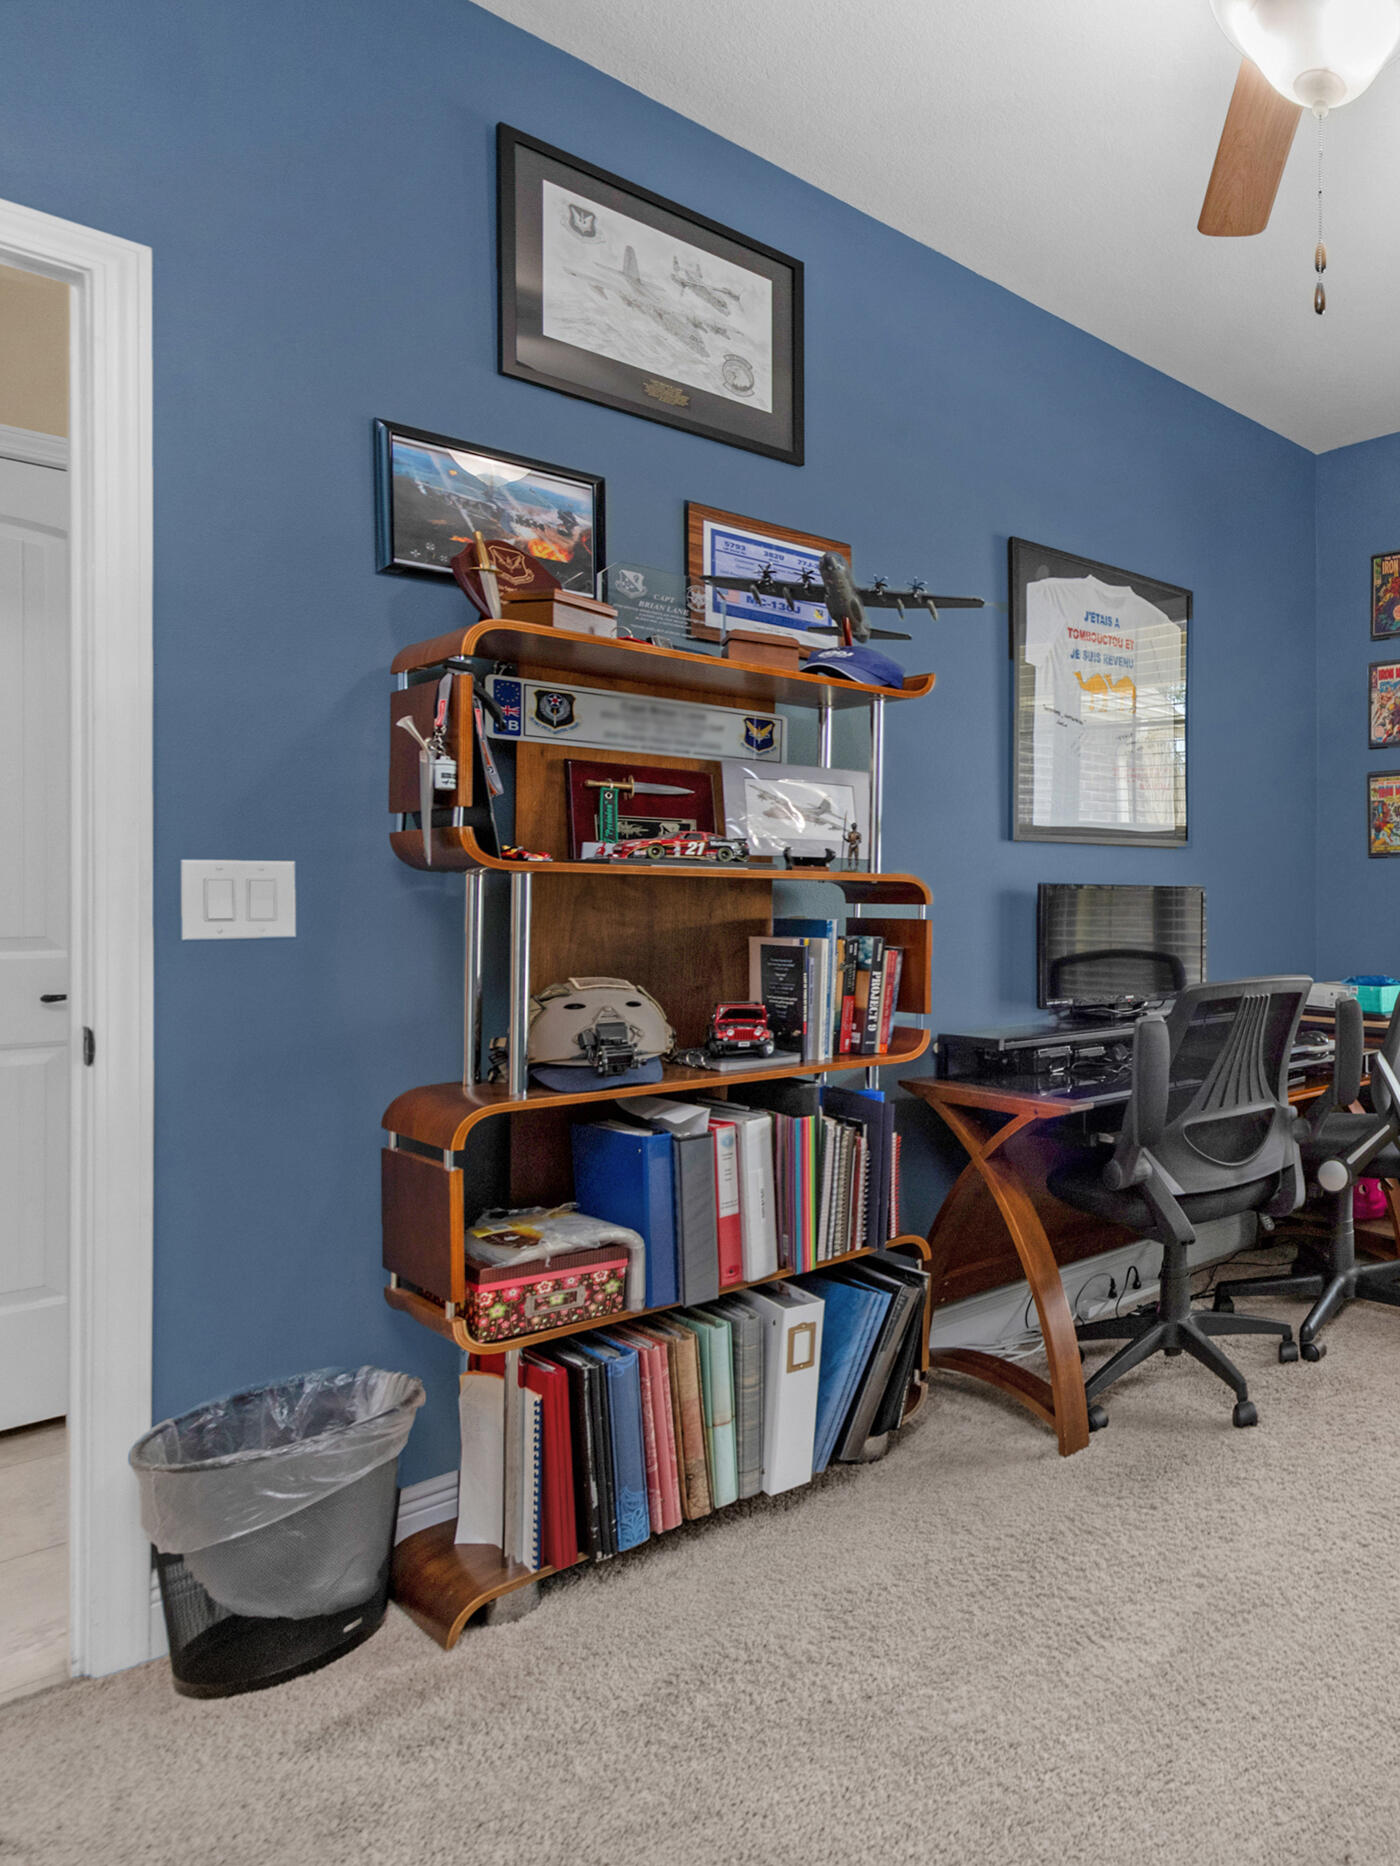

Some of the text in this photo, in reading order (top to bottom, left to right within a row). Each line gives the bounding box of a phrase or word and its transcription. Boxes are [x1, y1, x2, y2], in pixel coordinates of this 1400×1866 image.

[1382, 560, 1399, 575] IRON
[638, 600, 689, 616] BRIAN LANE
[1067, 627, 1124, 649] TOMBOUCTOU
[1070, 648, 1134, 669] JE SUIS REVENU
[685, 841, 705, 856] 21
[869, 970, 882, 1021] PROJECT
[867, 1023, 877, 1032] 9
